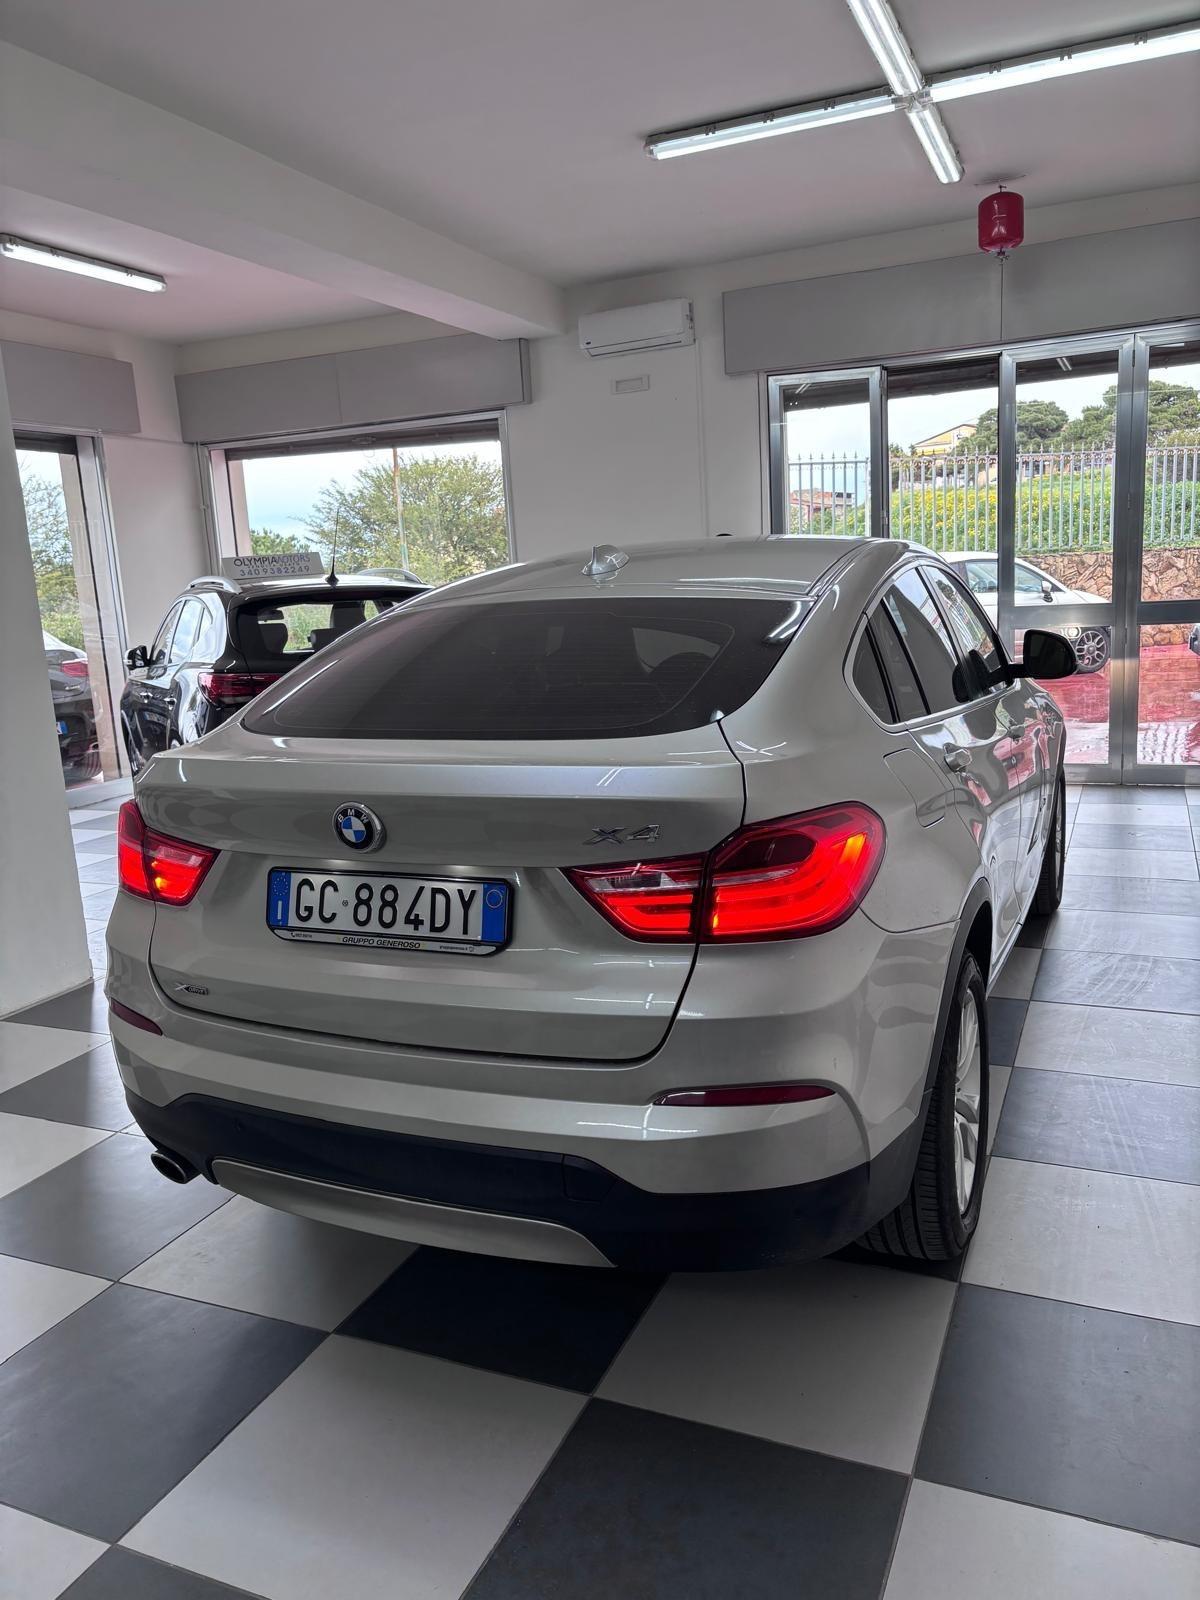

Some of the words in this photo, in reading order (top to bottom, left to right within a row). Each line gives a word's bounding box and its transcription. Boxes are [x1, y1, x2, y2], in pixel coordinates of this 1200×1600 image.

[337, 808, 369, 824] BMW
[582, 824, 660, 846] X4
[295, 878, 339, 924] GC
[352, 882, 477, 935] 884DY
[342, 936, 375, 945] GRUPPO
[376, 939, 421, 949] GENEROSO
